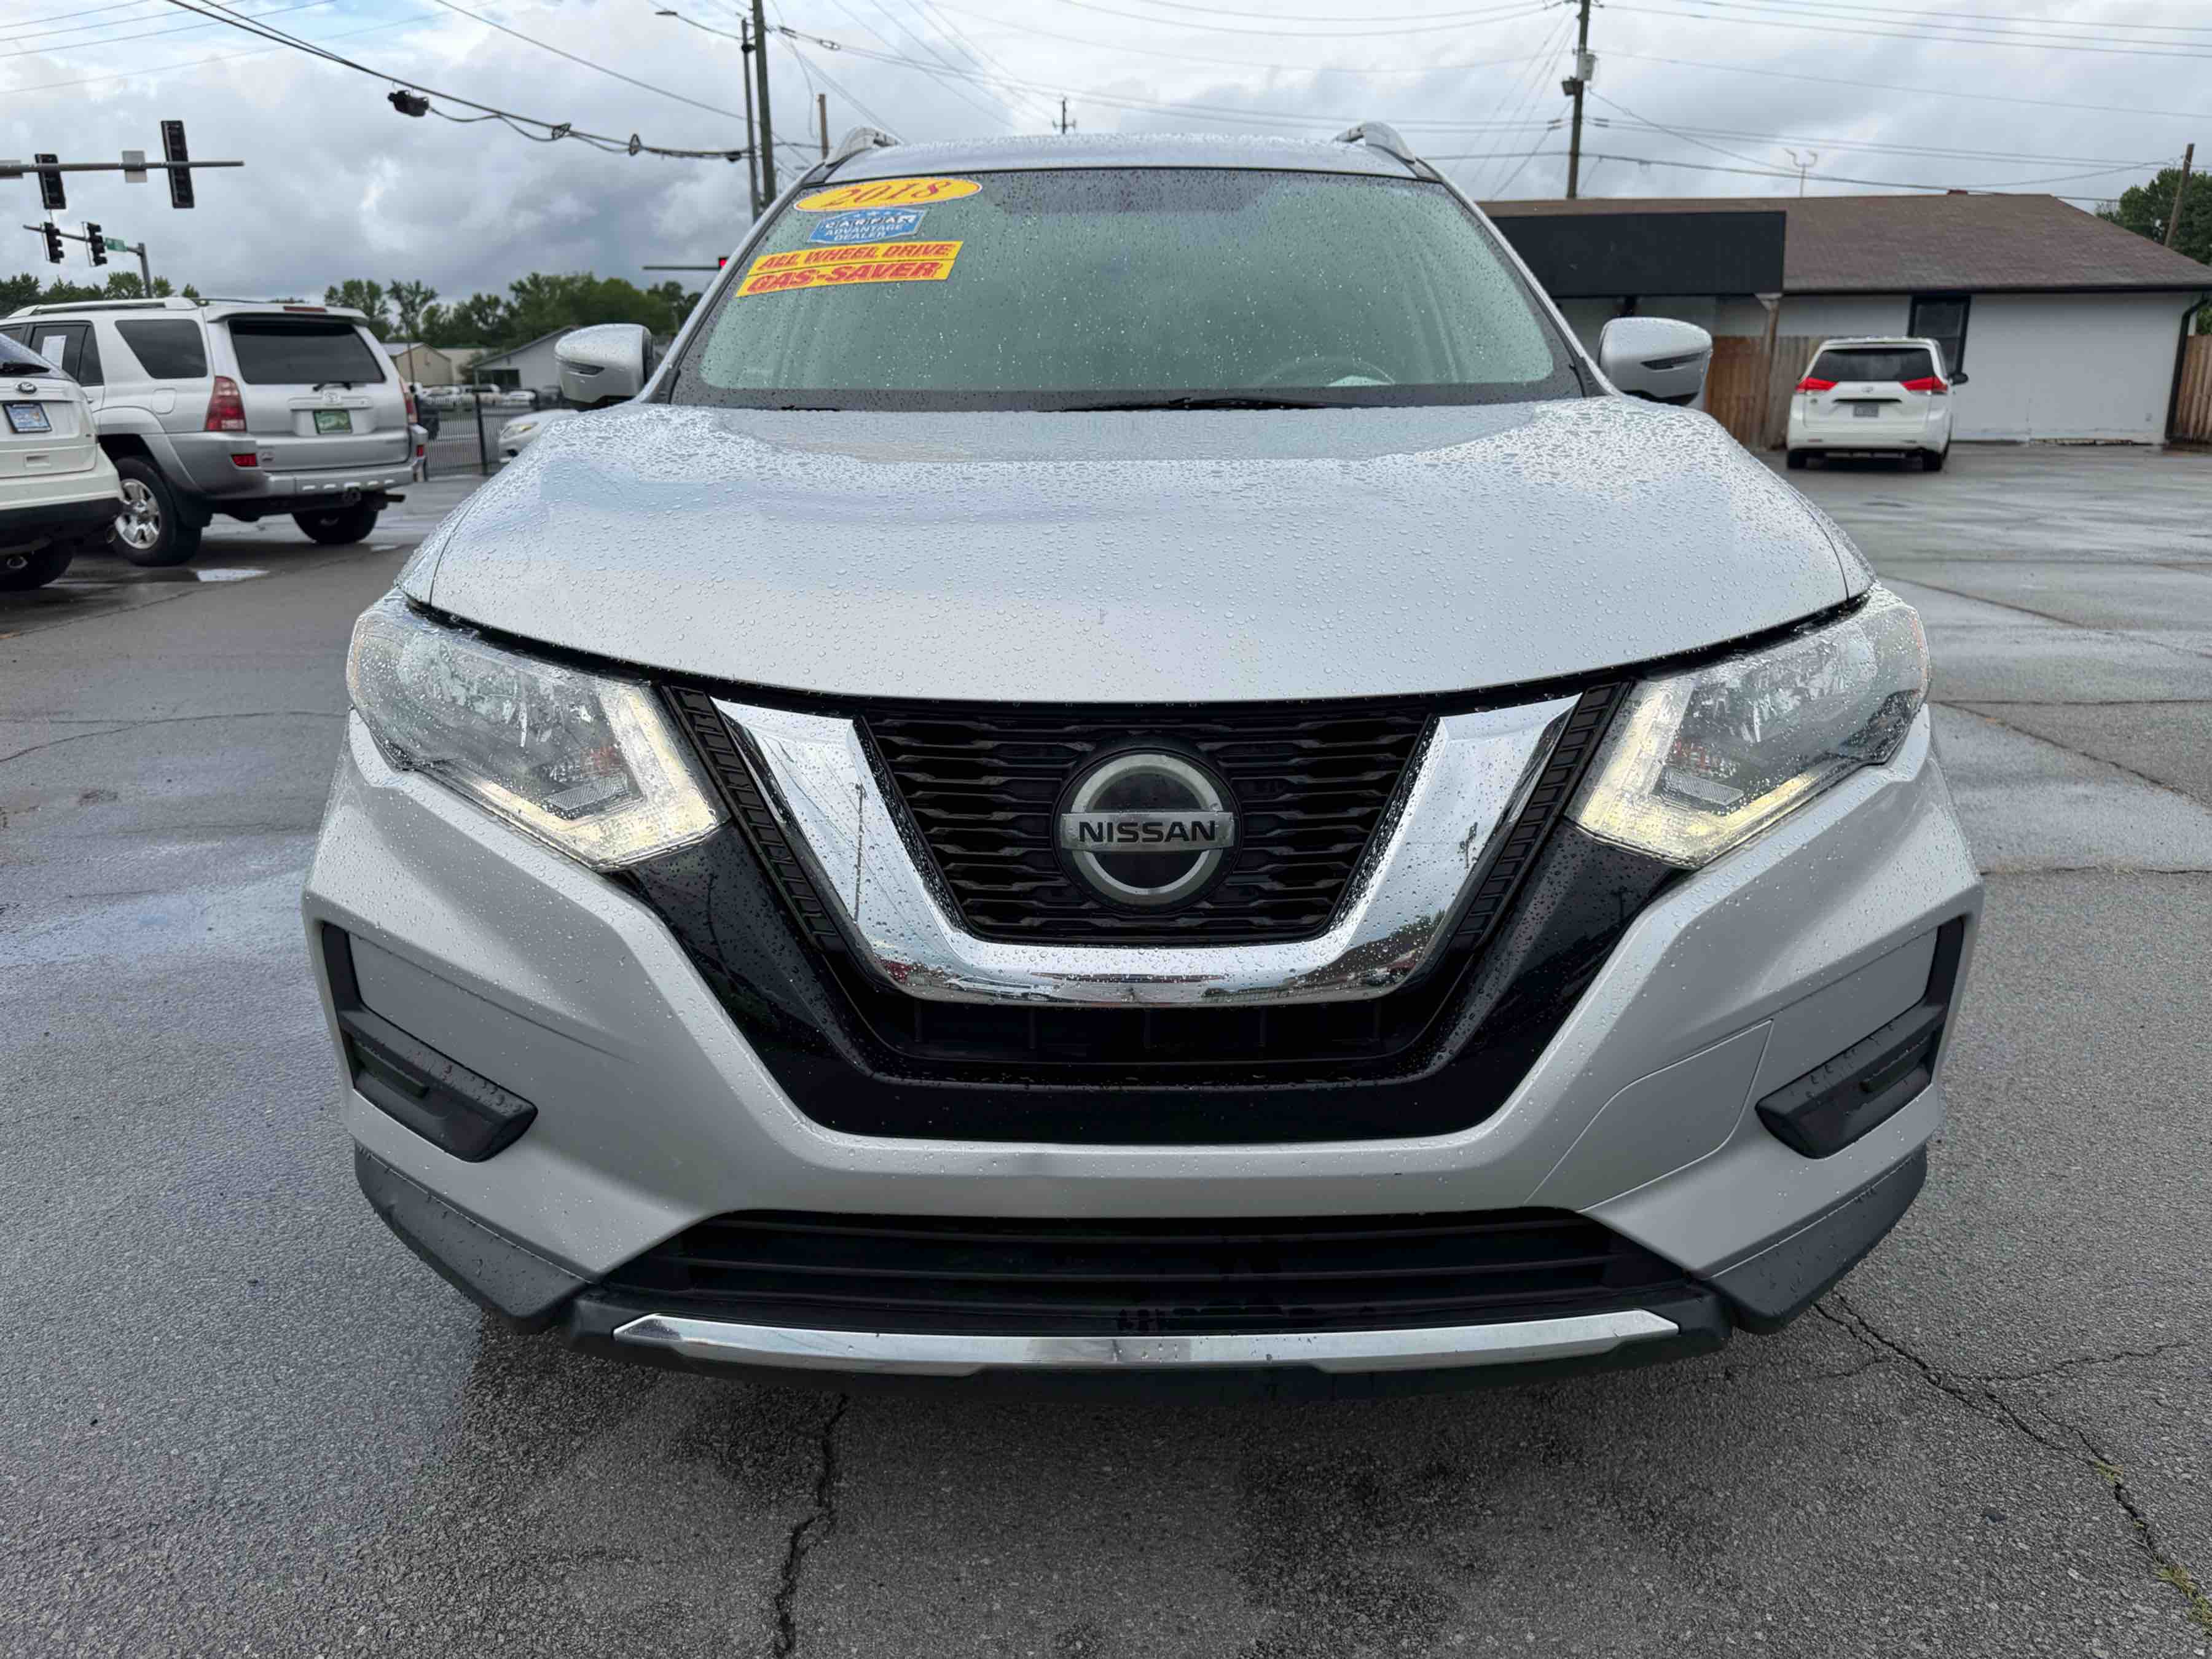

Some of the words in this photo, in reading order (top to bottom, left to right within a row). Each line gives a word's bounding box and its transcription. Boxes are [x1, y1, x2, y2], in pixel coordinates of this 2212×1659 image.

[820, 181, 952, 208] 2018
[825, 224, 903, 237] ADVANTAGE
[834, 231, 886, 241] DEALER
[756, 253, 801, 271] ALL
[805, 246, 879, 264] WHEEL
[882, 243, 957, 258] DRIVE
[747, 262, 943, 293] GAS-SAVER
[1079, 820, 1215, 843] NISSAN
